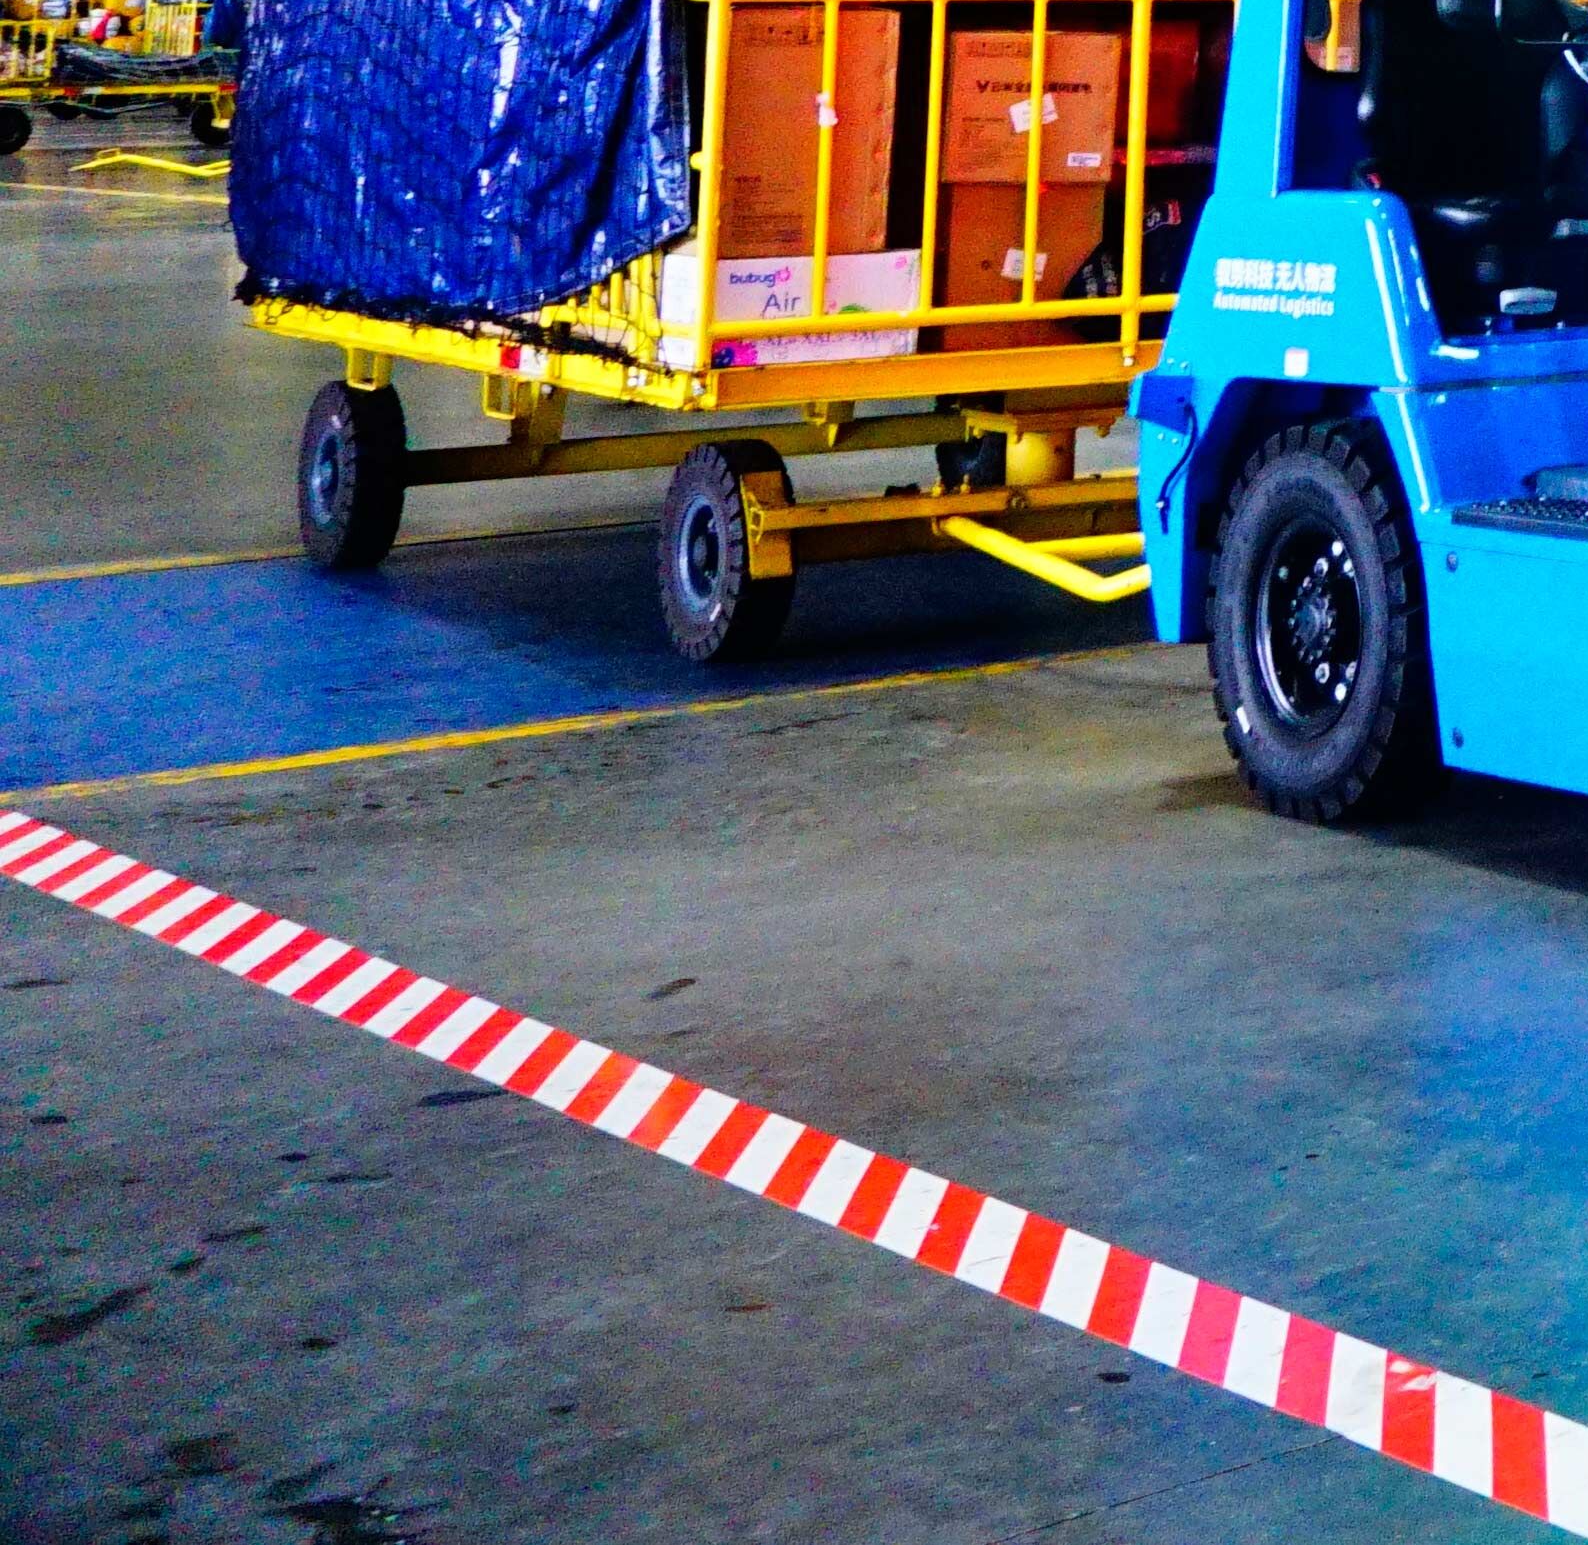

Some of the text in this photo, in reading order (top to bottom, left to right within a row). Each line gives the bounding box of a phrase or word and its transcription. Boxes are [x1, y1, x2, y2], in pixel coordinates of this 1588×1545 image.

[762, 292, 801, 313] Air
[1213, 291, 1335, 320] Automated Logistics
